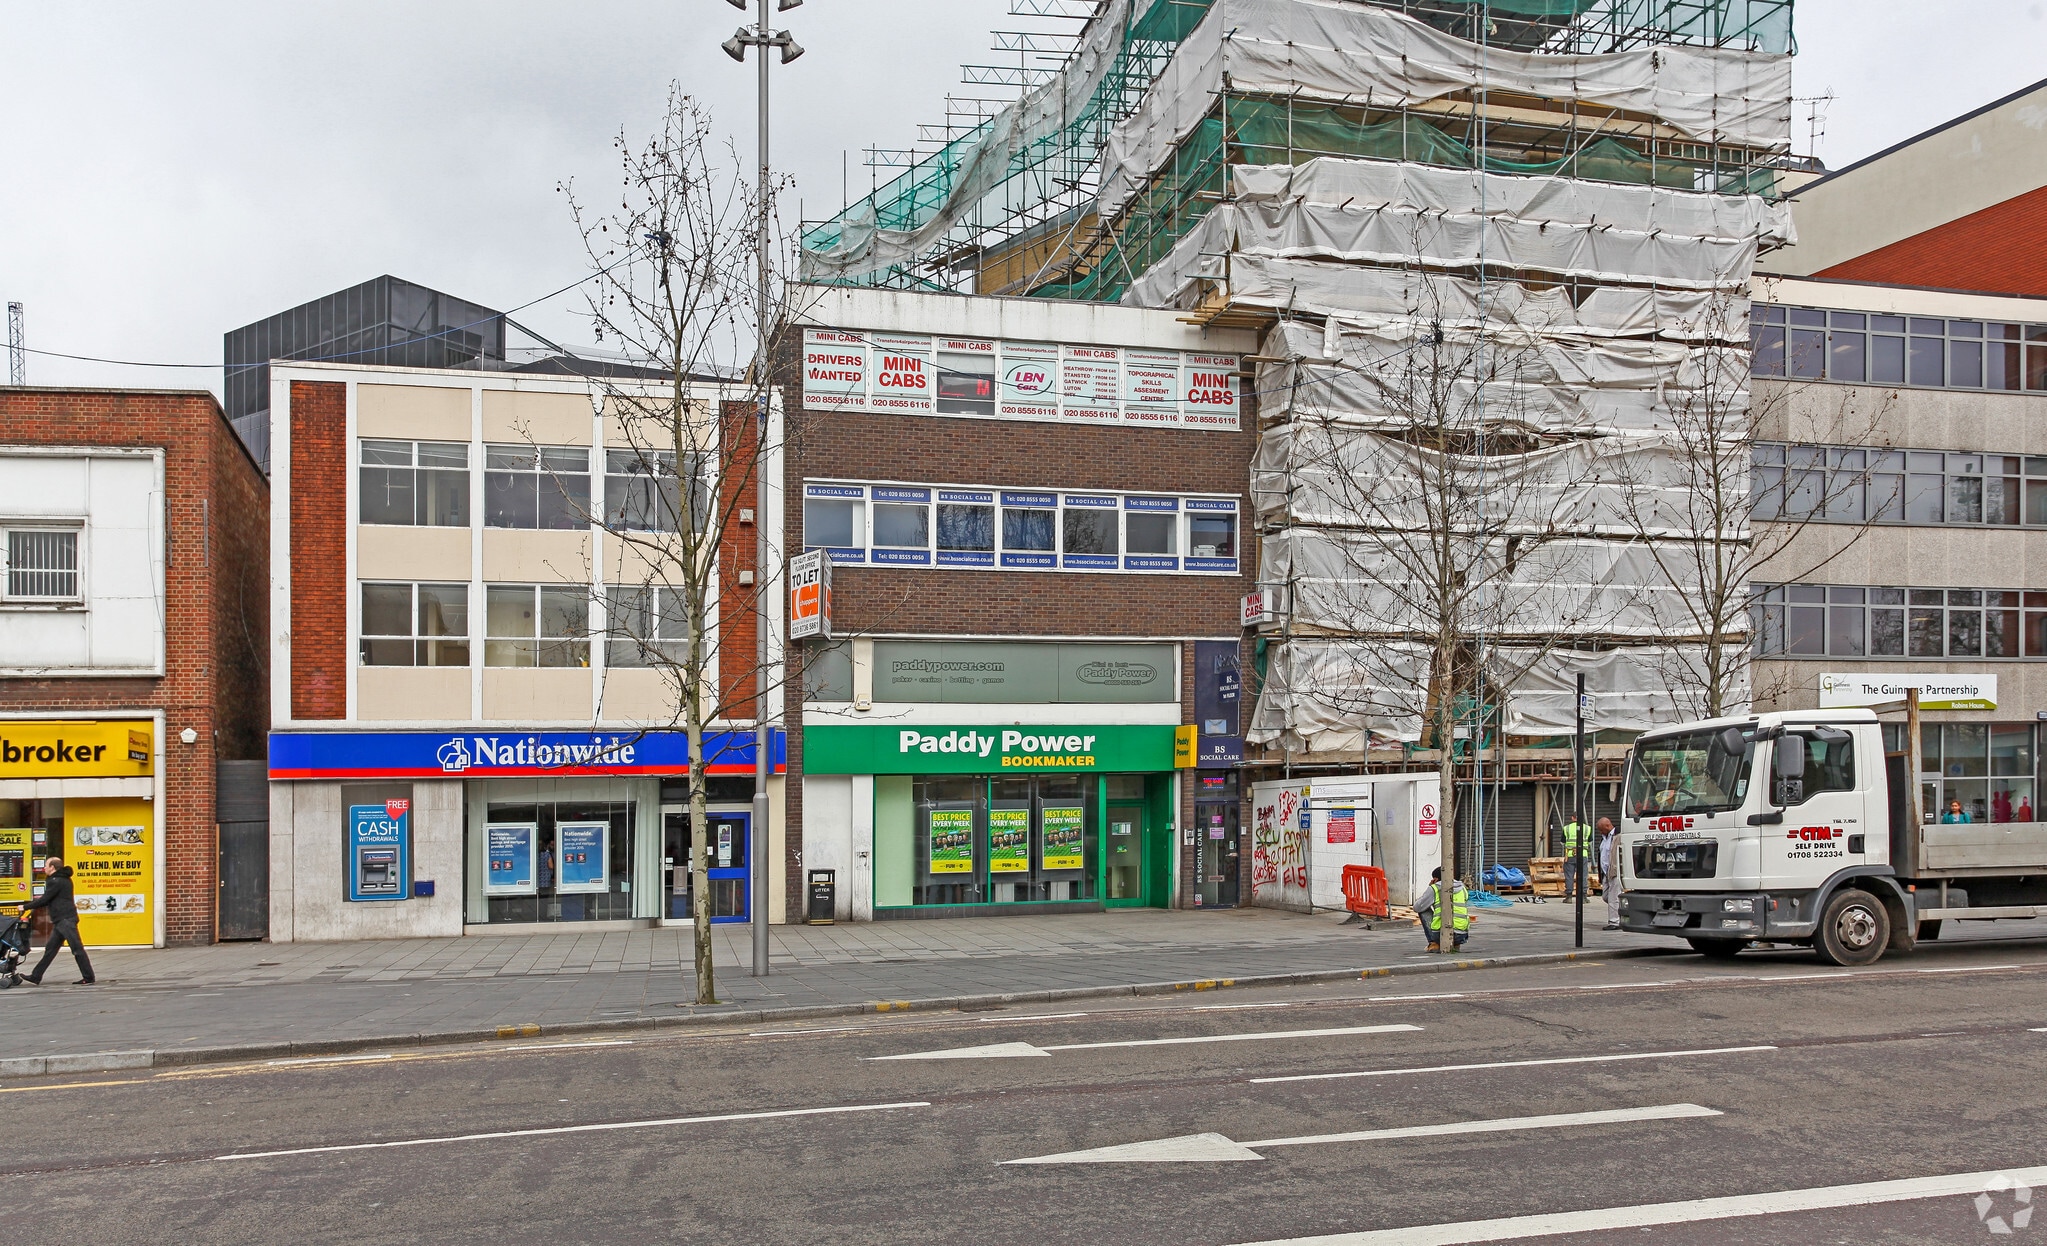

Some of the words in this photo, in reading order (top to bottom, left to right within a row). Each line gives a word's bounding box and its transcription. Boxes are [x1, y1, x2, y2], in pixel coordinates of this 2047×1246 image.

[838, 334, 862, 342] CABS
[808, 354, 862, 366] DRIVERS
[884, 357, 921, 372] MINI
[808, 370, 861, 382] WANTED
[879, 373, 926, 388] CABS
[1015, 372, 1044, 382] LBN
[1193, 373, 1229, 388] MINI
[1188, 389, 1233, 405] CABS
[910, 401, 929, 409] 6116
[792, 574, 801, 587] TO
[804, 569, 819, 584] LET
[1247, 593, 1261, 606] MINI
[1245, 604, 1262, 618] CABS
[893, 659, 1004, 673] paddypower.com
[1084, 668, 1117, 679] Paddy
[1118, 668, 1152, 677] Power
[1862, 685, 1878, 694] The
[1881, 685, 1923, 694] Guinns
[1927, 685, 1978, 696] Partnership
[900, 731, 995, 757] Paddy
[1002, 730, 1095, 752] Power
[474, 737, 635, 765] Nationwide
[1002, 756, 1095, 766] BOOKMAKER
[388, 801, 407, 809] FREE
[358, 821, 398, 836] CASH
[1658, 816, 1684, 832] CTM
[1800, 826, 1831, 841] CTM
[1657, 853, 1686, 862] MAN
[77, 861, 89, 869] WE
[112, 861, 124, 869] WE
